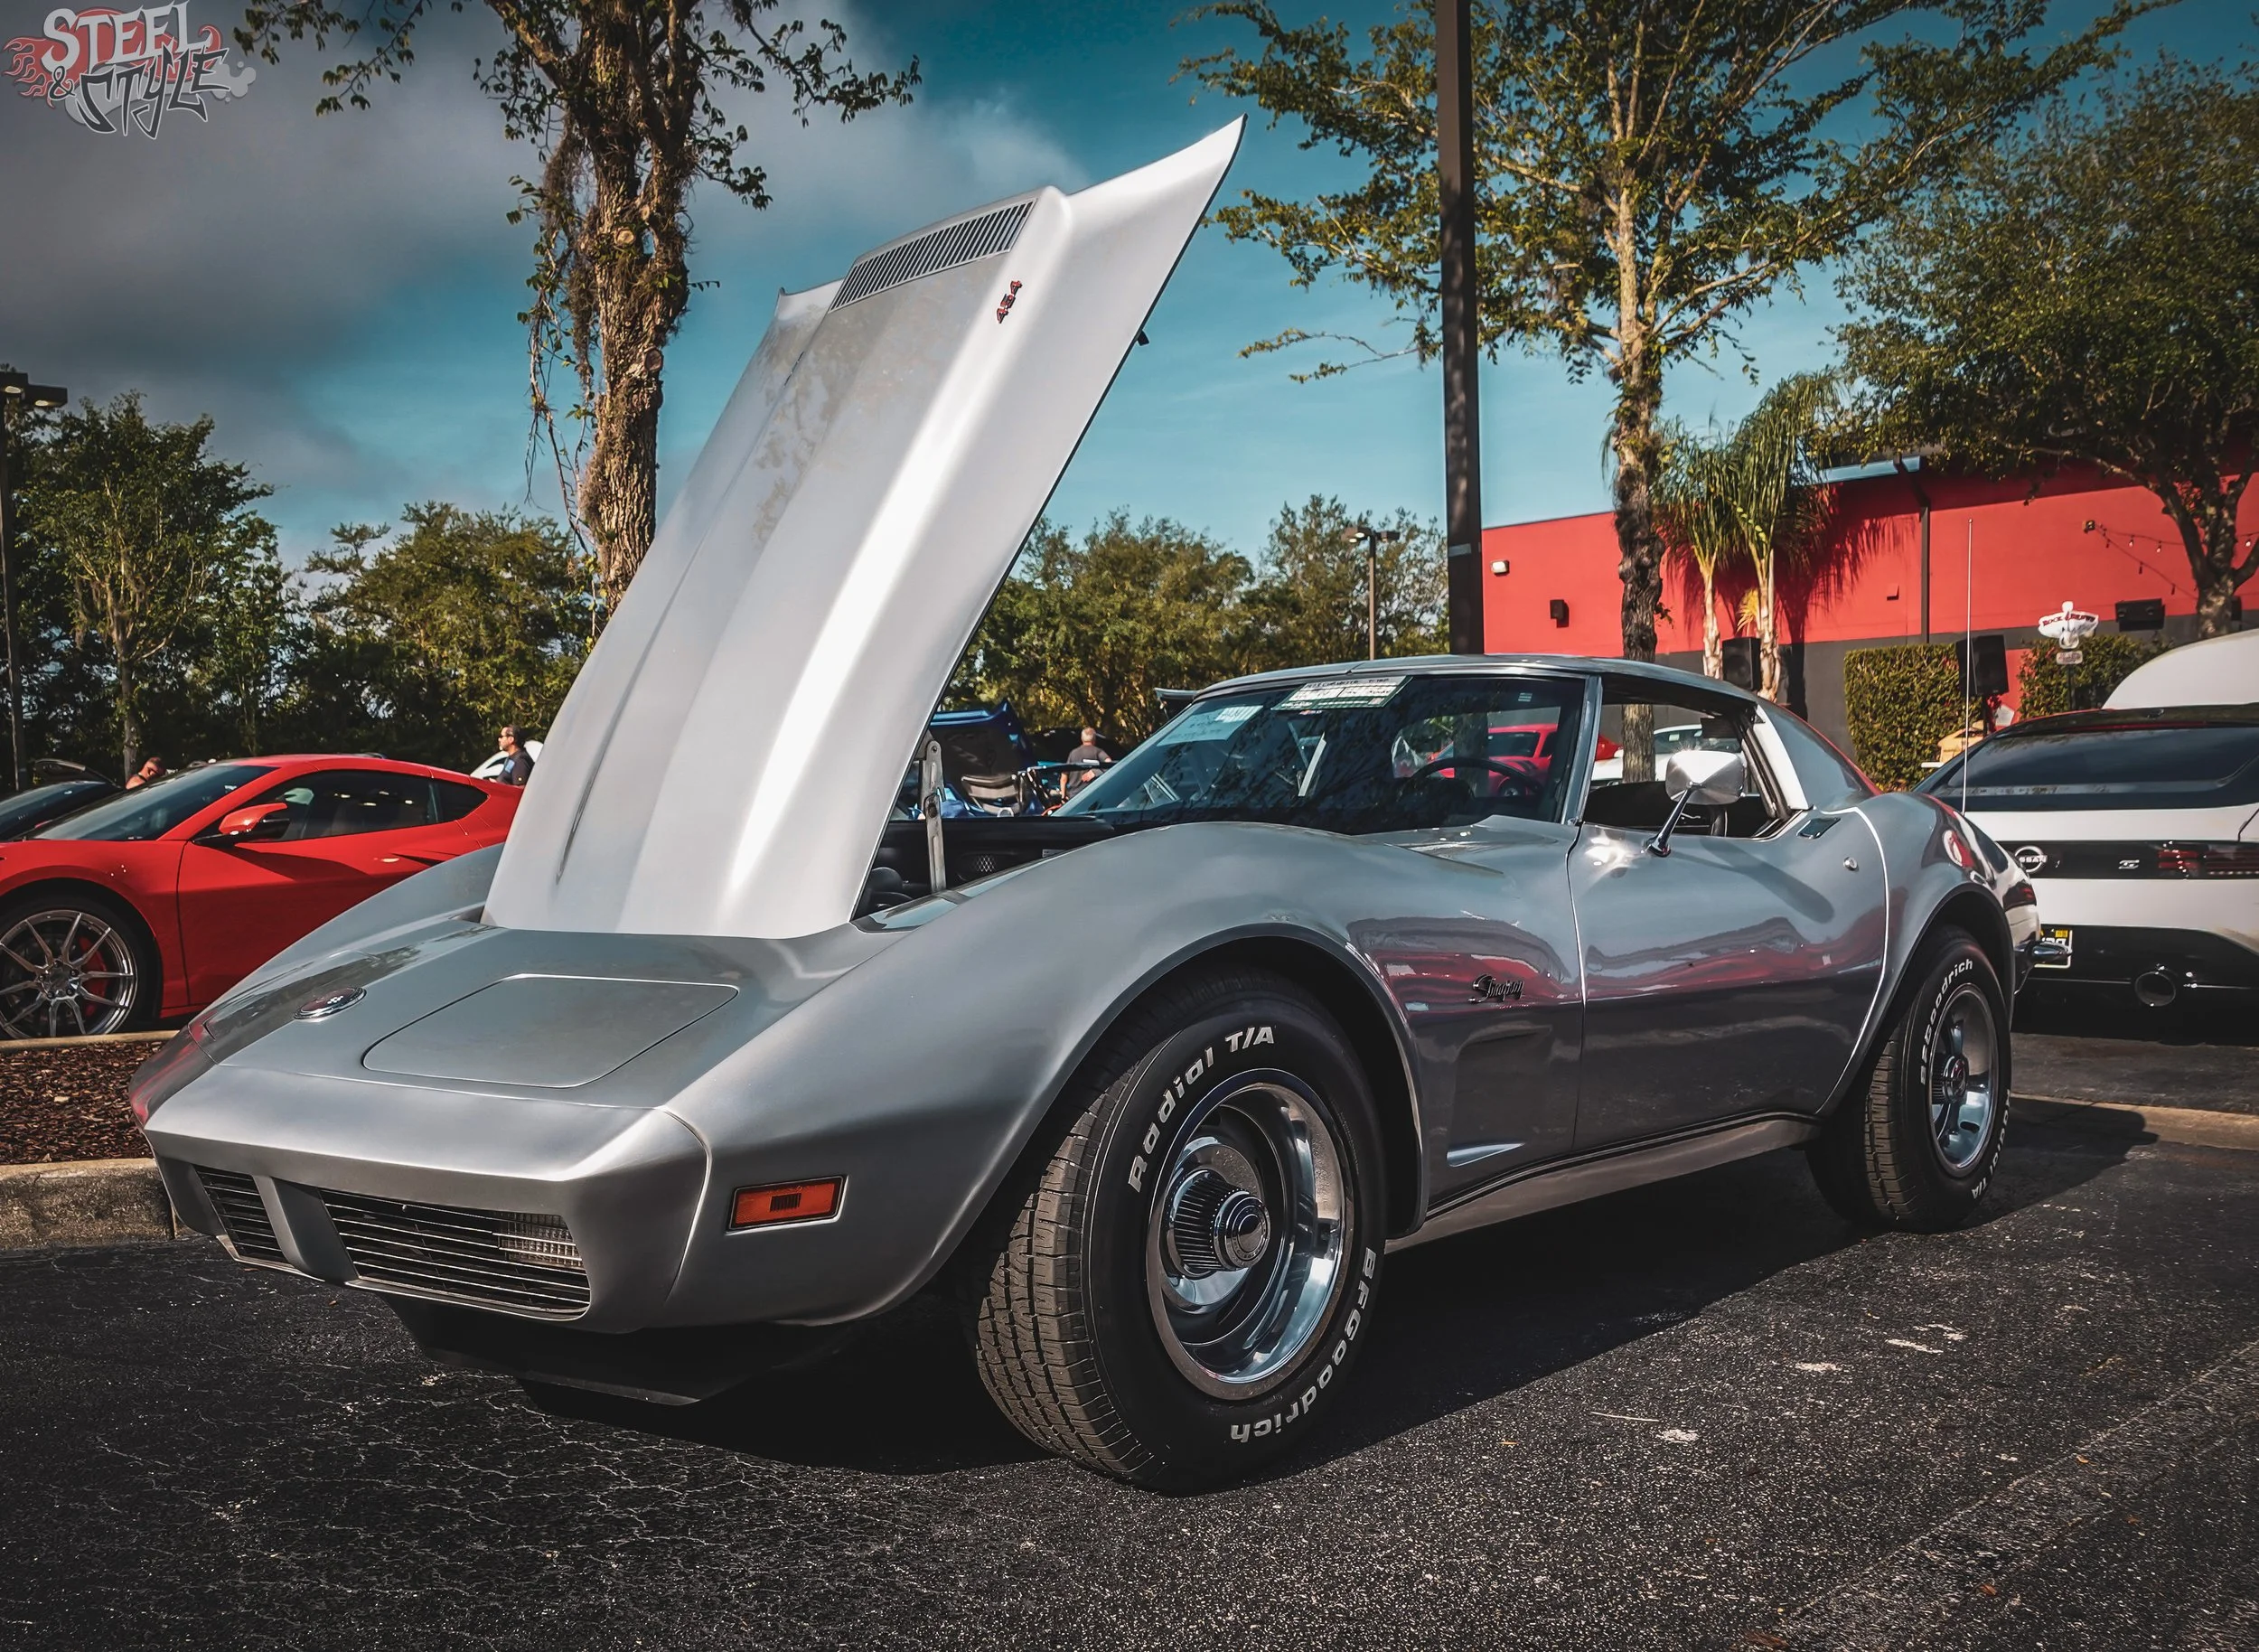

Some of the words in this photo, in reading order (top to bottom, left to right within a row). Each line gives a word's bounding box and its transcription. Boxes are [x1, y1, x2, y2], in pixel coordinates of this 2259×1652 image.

[997, 280, 1023, 324] 454
[2018, 855, 2048, 863] SSAN
[1128, 1047, 1214, 1193] Radial
[1224, 1026, 1275, 1053] T/A
[1231, 1247, 1377, 1443] BFGoodrich
